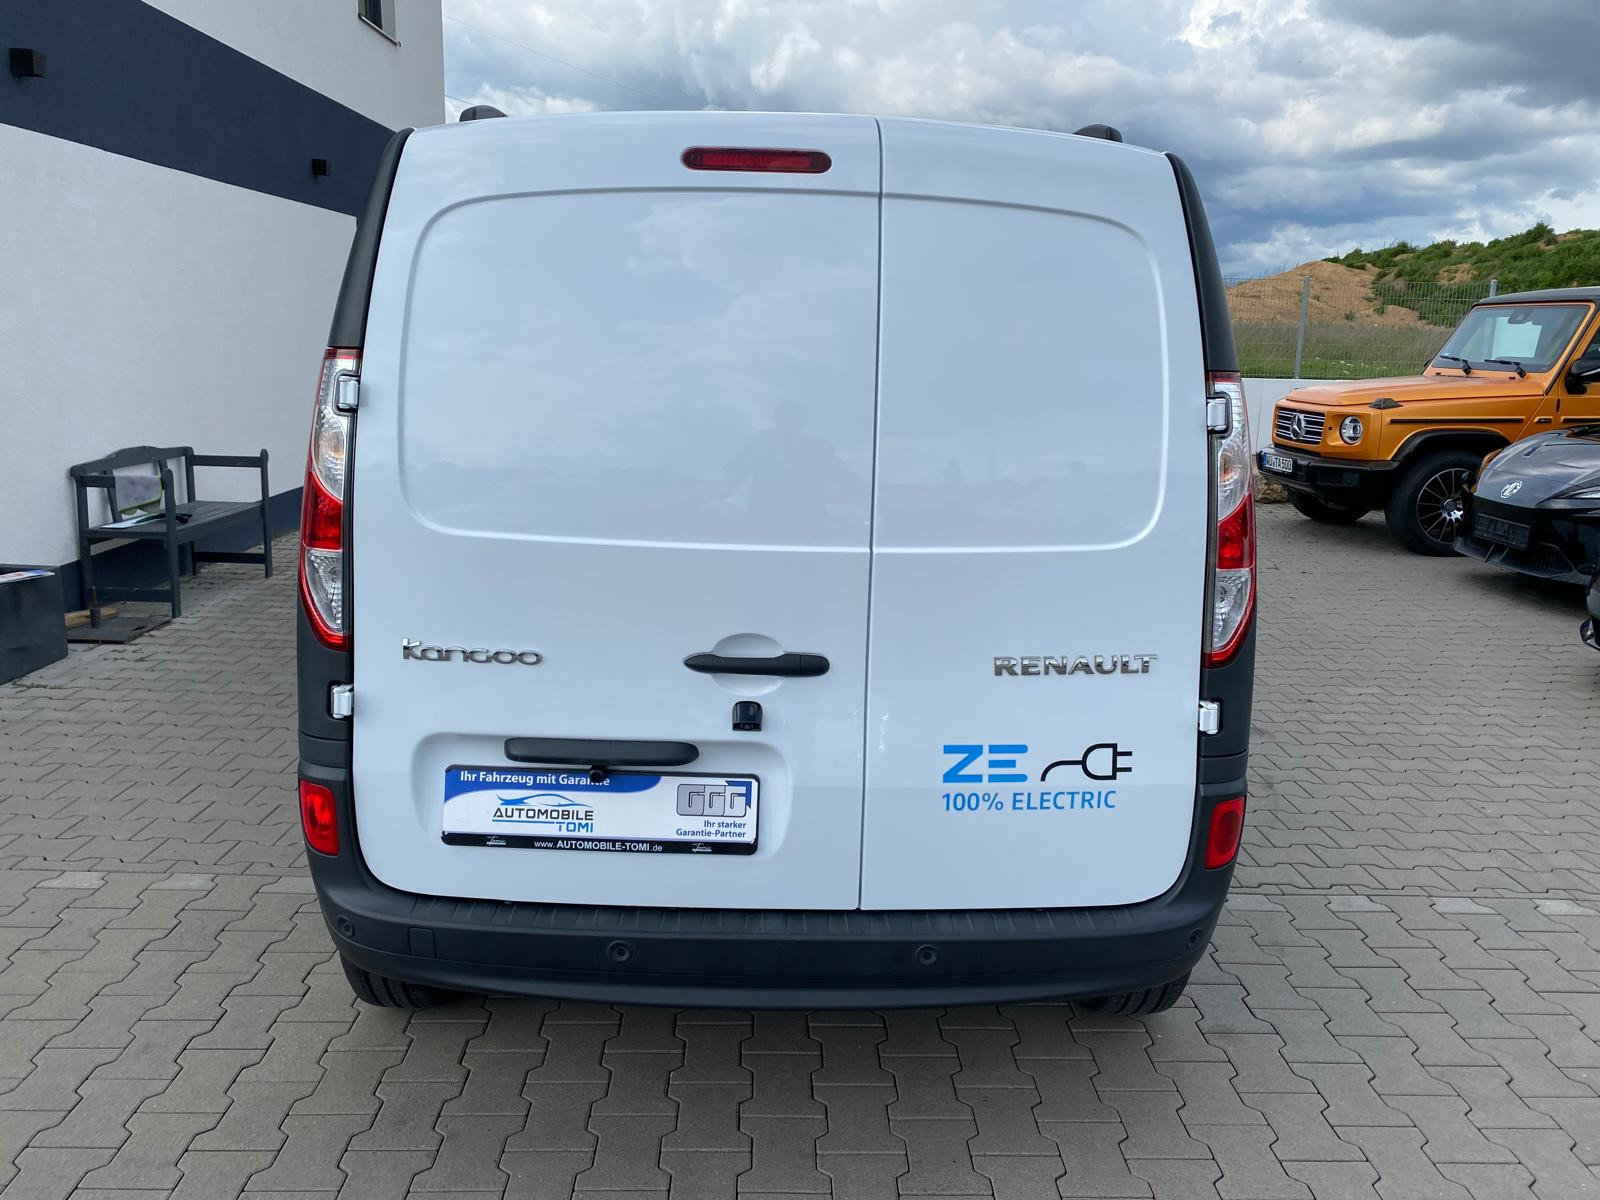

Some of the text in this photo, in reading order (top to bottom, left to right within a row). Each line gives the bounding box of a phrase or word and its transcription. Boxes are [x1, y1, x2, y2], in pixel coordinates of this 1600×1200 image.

[993, 654, 1158, 677] RENAULT
[942, 744, 1029, 784] ZE
[460, 770, 477, 782] Ihr
[479, 772, 534, 786] Fahrzeug
[536, 774, 557, 785] mit
[942, 790, 1117, 812] 100% ELECTRIC
[492, 807, 595, 821] AUTOMOBILE
[555, 821, 594, 834] TOMI
[704, 819, 747, 830] Ihr starker
[675, 828, 747, 839] Garantie-Partner
